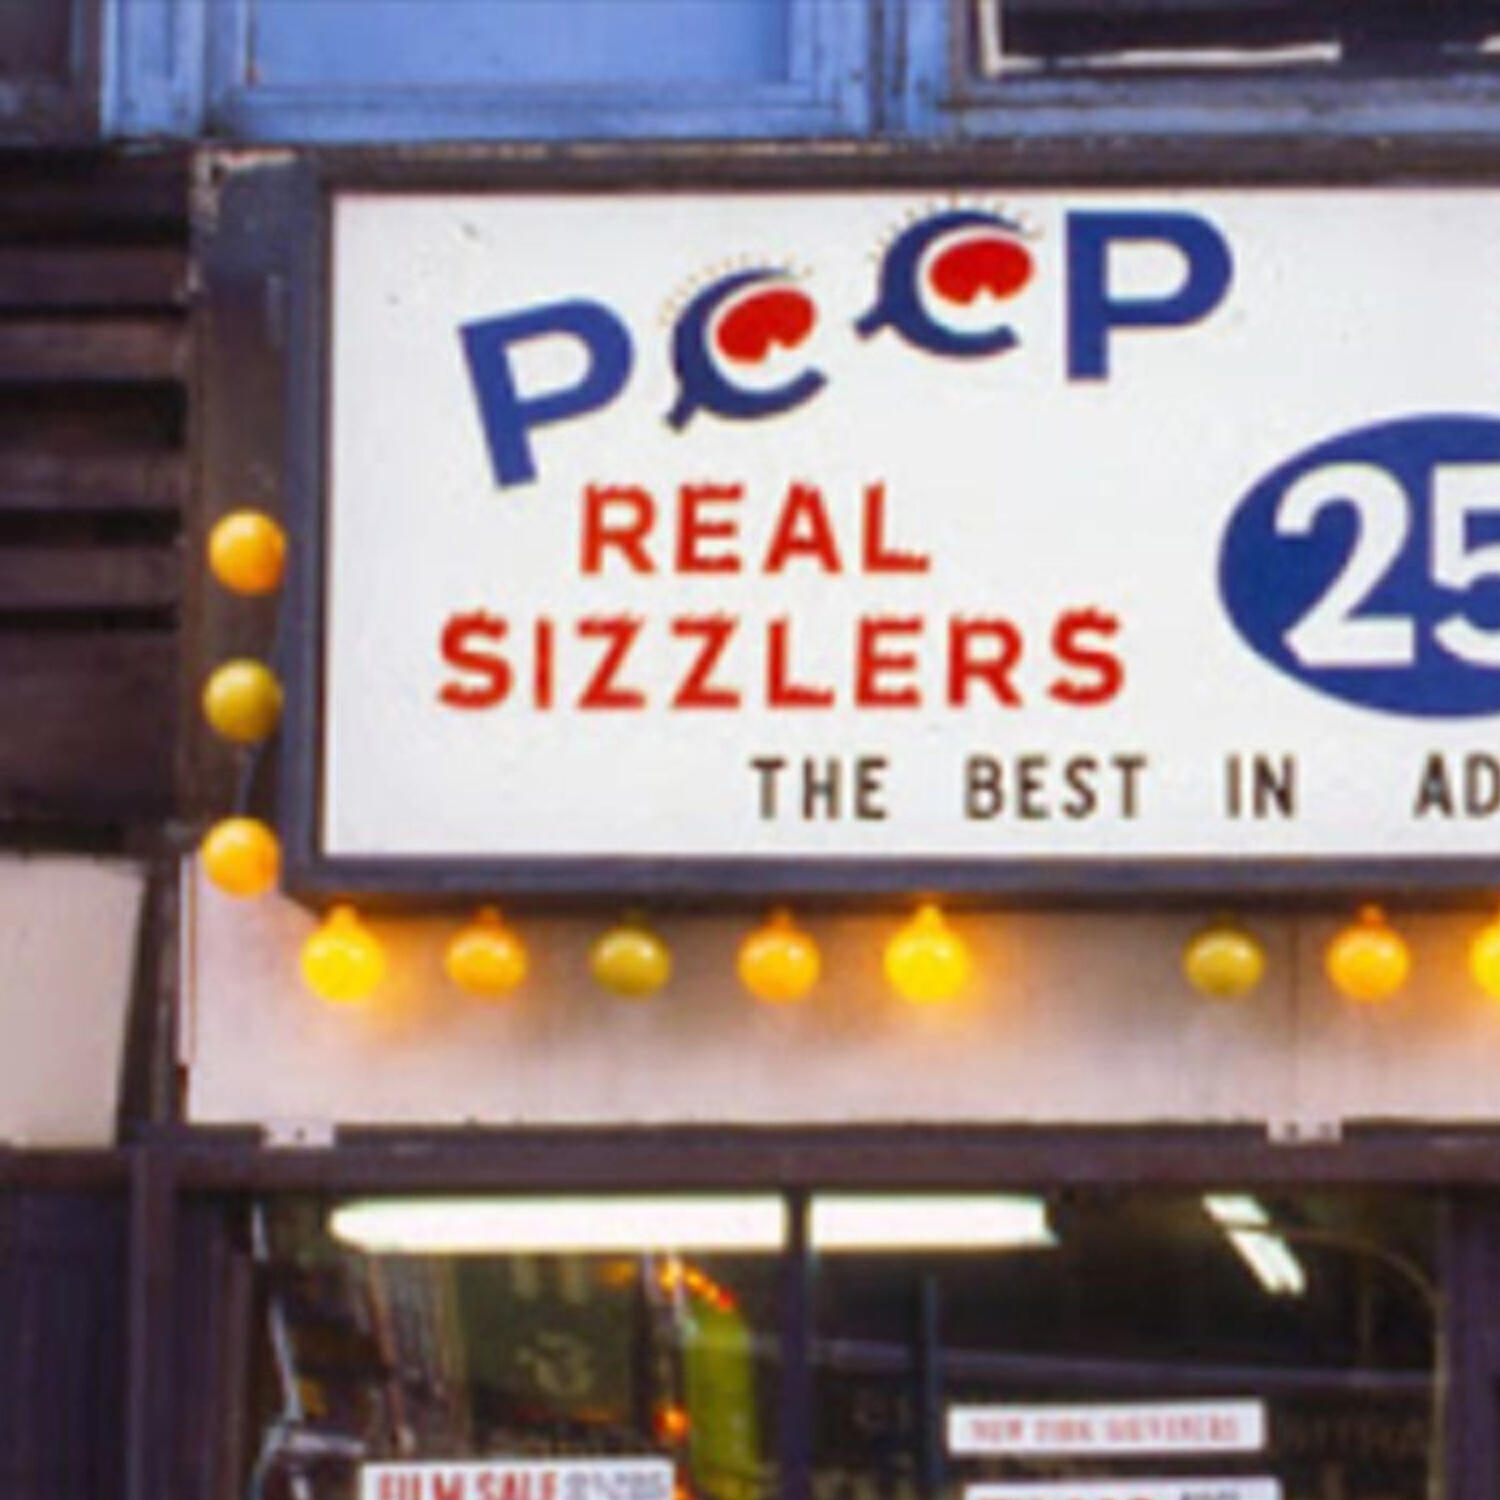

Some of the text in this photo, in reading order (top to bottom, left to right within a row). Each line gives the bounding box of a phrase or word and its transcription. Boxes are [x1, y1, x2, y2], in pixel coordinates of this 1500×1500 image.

[461, 203, 1233, 486] PEEP
[580, 483, 929, 575] REAL
[751, 755, 888, 822] THE
[964, 754, 1147, 822] BEST
[1226, 755, 1296, 819] IN
